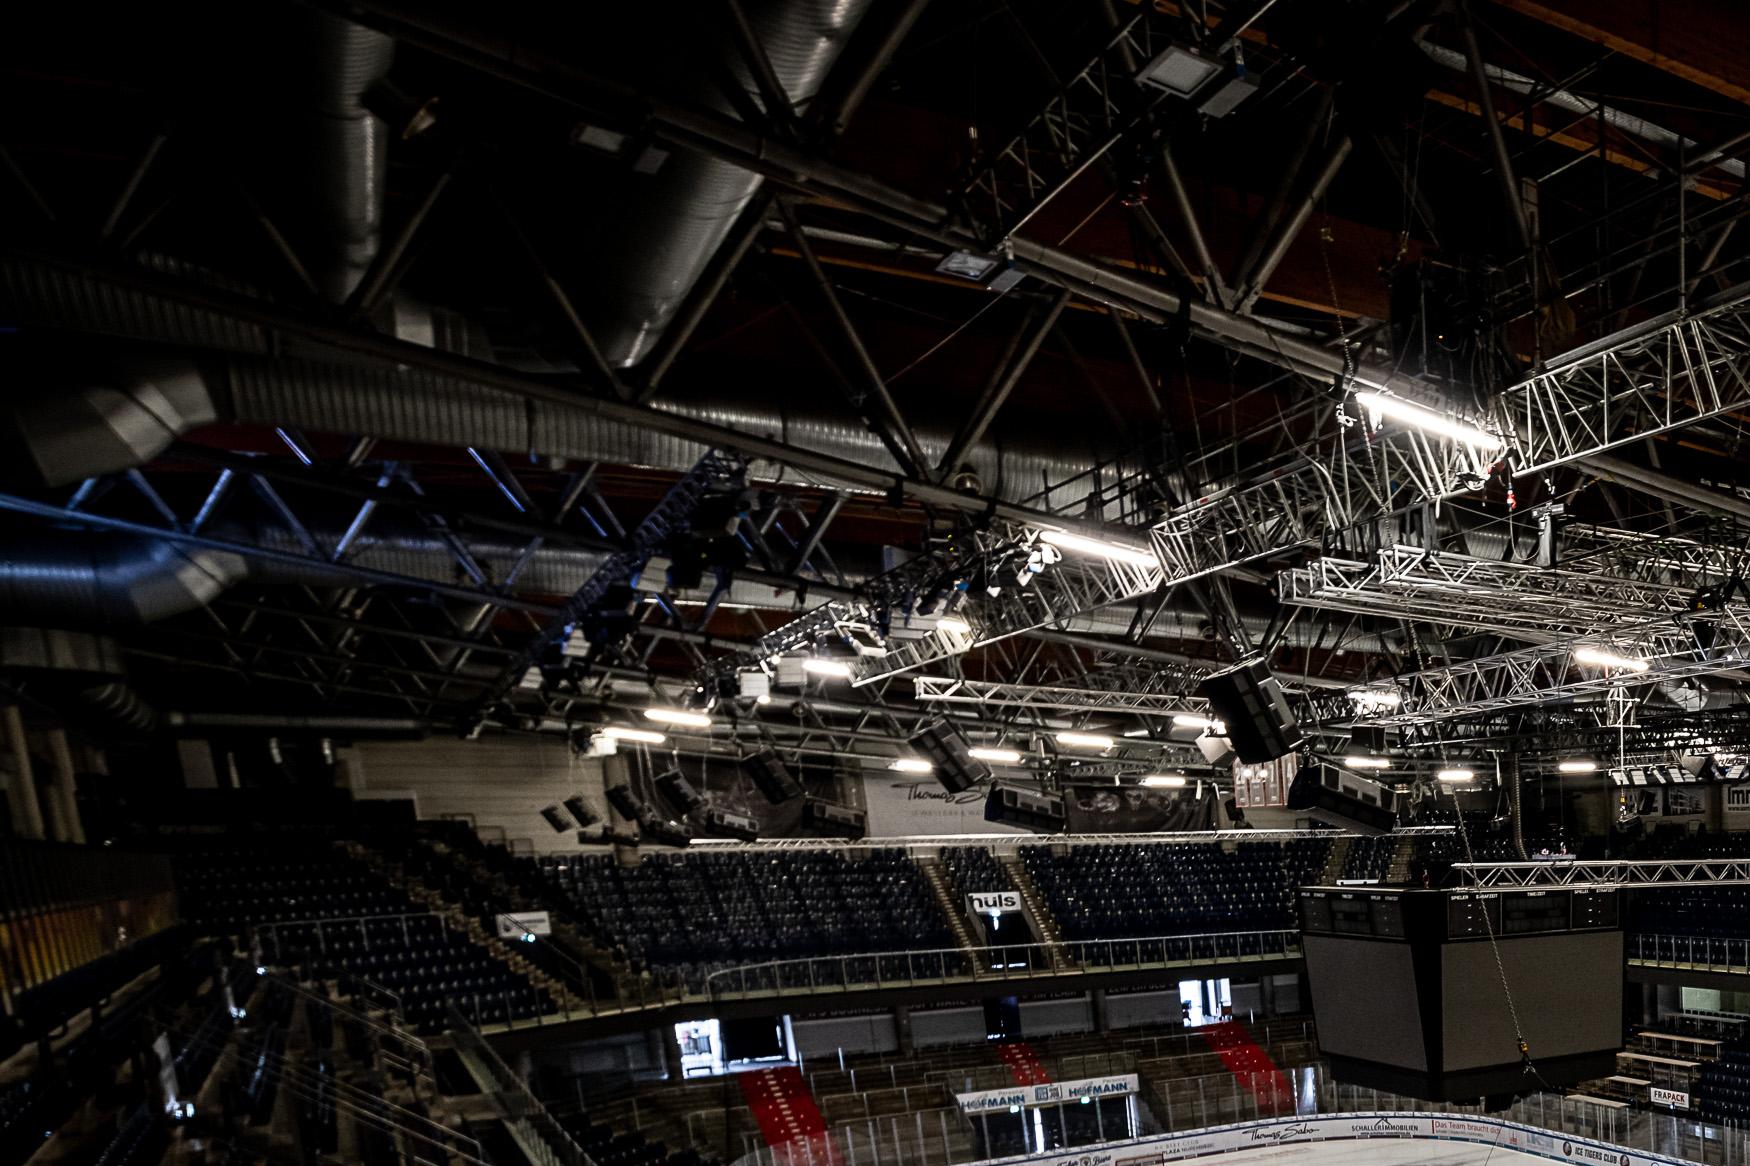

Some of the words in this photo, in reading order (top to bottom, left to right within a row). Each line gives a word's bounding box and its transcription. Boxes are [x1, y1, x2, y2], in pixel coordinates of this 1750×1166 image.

[1068, 1081, 1128, 1097] HOFMANN
[1654, 1090, 1685, 1103] FRAPACK
[960, 1094, 1025, 1110] HOFMANN
[1242, 1126, 1281, 1141] Thomas
[1280, 1123, 1320, 1140] Sabo
[1435, 1120, 1447, 1129] Das
[1449, 1121, 1466, 1130] Team
[1467, 1122, 1489, 1133] braucht
[1574, 1146, 1584, 1157] ICE
[1584, 1149, 1603, 1161] TIGERS
[1603, 1153, 1618, 1165] CLUB
